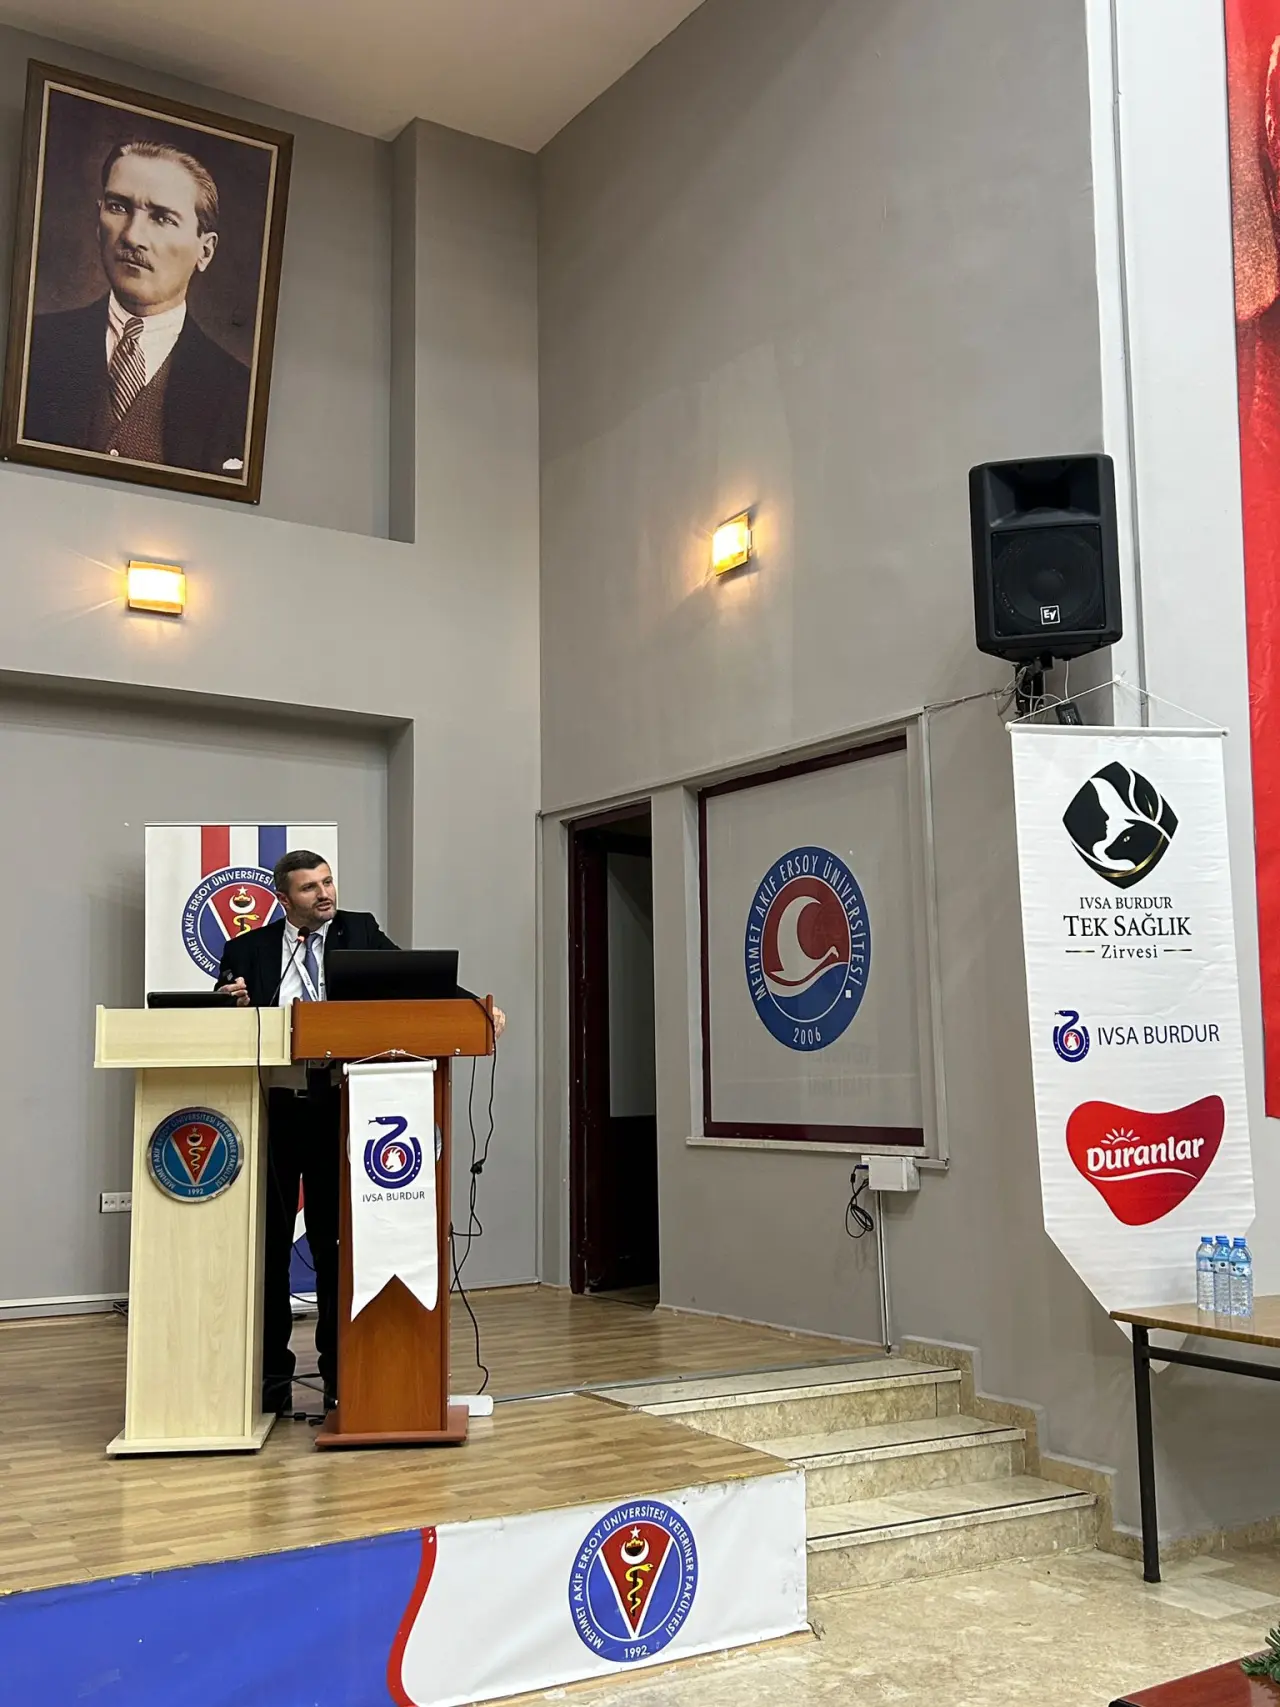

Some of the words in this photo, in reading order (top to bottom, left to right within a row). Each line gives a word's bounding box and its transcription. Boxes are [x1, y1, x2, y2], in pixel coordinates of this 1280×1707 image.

[212, 870, 275, 887] ÜNİVERSİTESİ
[779, 854, 818, 882] ERSOY
[188, 883, 212, 912] ERSOY
[755, 876, 777, 918] AKİF
[1079, 896, 1112, 910] IVSA
[1115, 896, 1173, 910] BURDUR
[184, 912, 195, 934] AKİF
[1063, 915, 1109, 937] TEK
[1114, 912, 1192, 937] SAĞLIK
[187, 937, 216, 972] MEHMET
[748, 925, 767, 1001] MEHMET
[1101, 944, 1158, 959] Zirvesi
[793, 1026, 822, 1045] 2006
[1097, 1026, 1139, 1046] IVSA
[1143, 1023, 1220, 1044] BURDUR
[1086, 1136, 1205, 1172] Duranlar
[362, 1193, 383, 1202] IVSA
[386, 1191, 425, 1201] BURDUR
[603, 1504, 668, 1532] ÜNİVERSİTESİ
[578, 1529, 603, 1570] ERSOY
[669, 1516, 694, 1572] VETERİNER
[572, 1573, 584, 1602] AKİF
[575, 1606, 604, 1649] MEHMET
[624, 1645, 648, 1659] 1992
